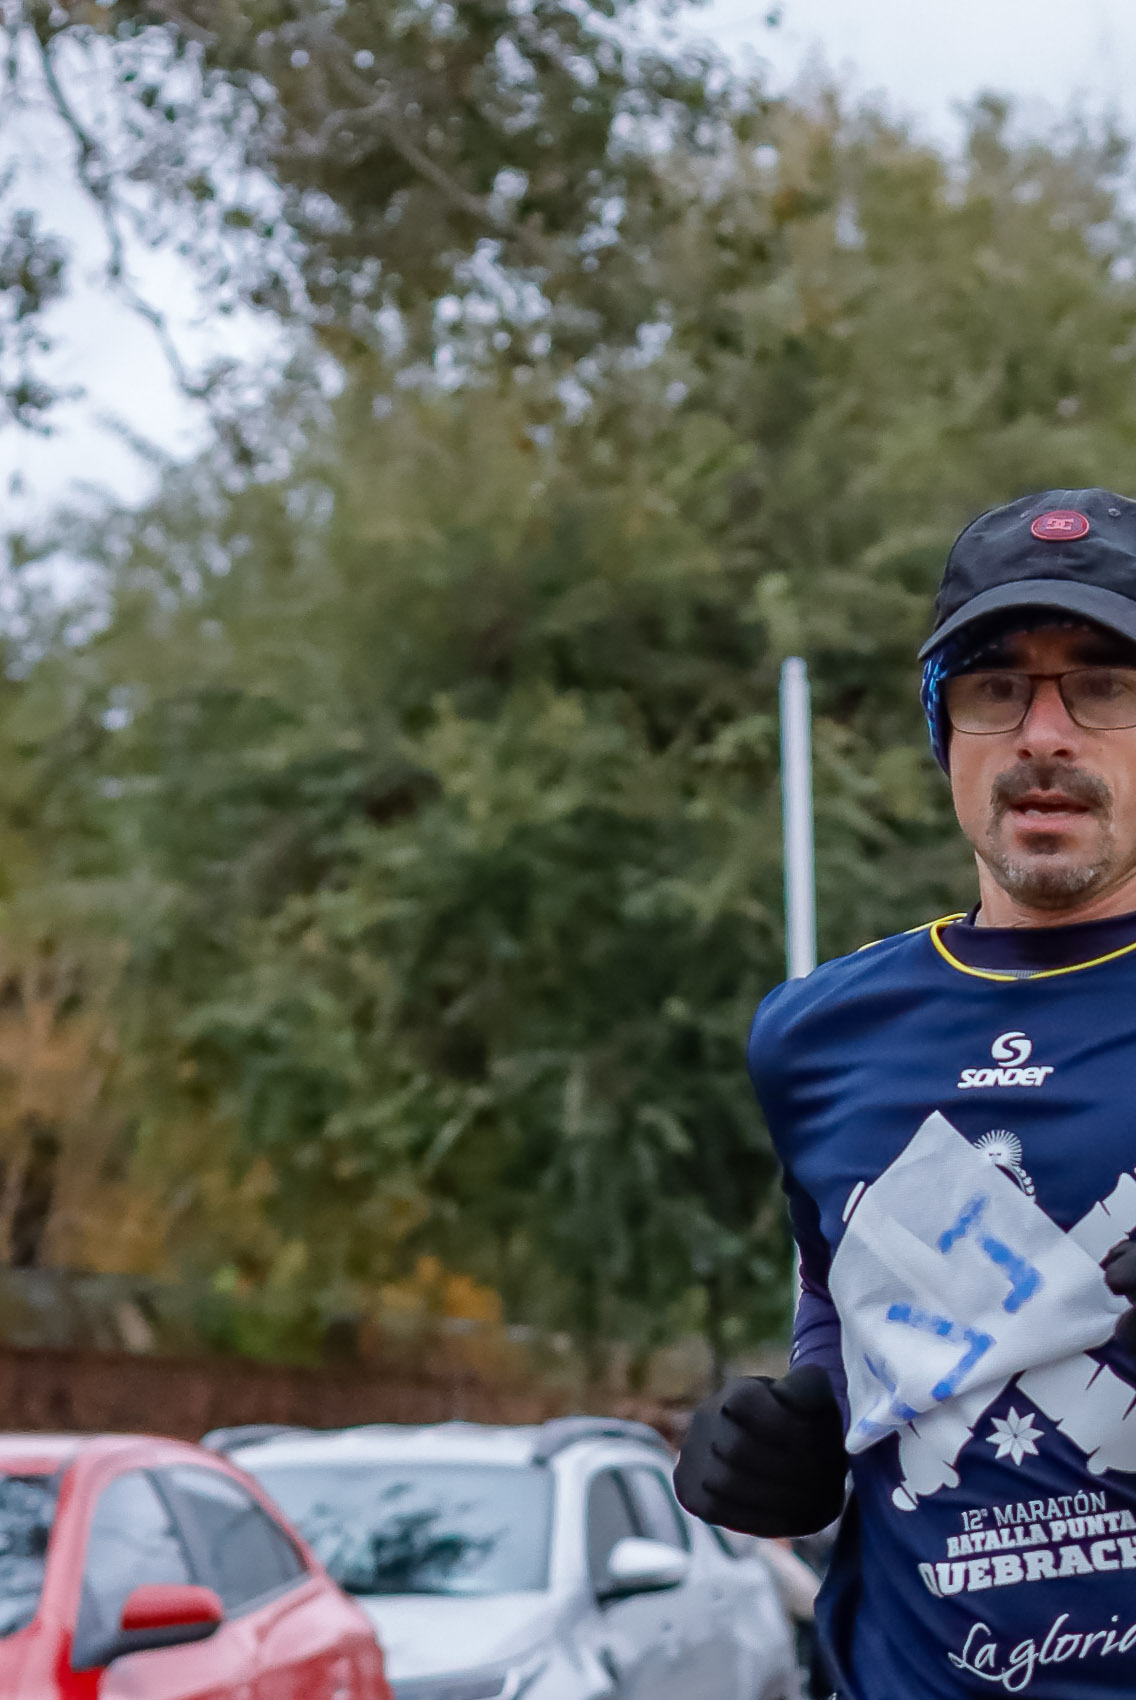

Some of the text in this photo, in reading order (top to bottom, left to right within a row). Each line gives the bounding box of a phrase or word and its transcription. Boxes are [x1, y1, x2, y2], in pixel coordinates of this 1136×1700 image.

[992, 1489, 1106, 1527] MARATÓN
[946, 1523, 1049, 1558] BATALLA
[948, 1622, 1004, 1681] La
